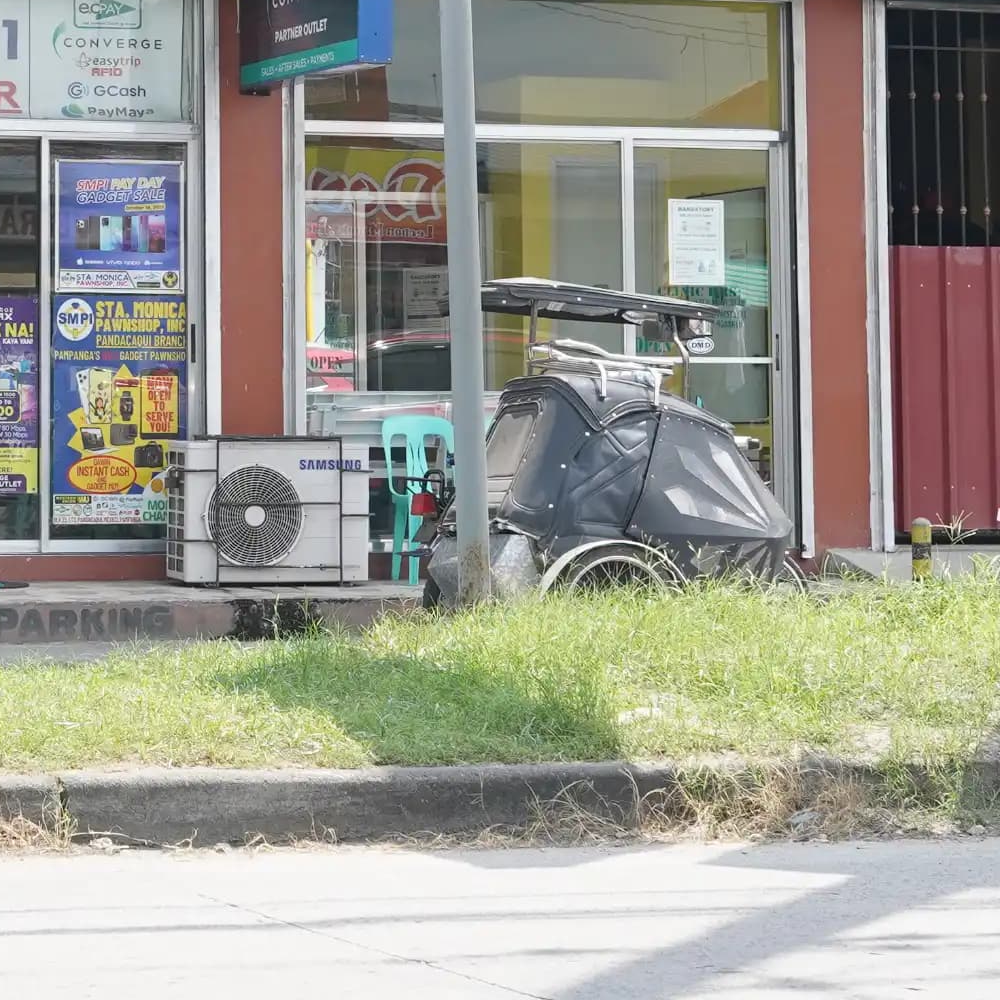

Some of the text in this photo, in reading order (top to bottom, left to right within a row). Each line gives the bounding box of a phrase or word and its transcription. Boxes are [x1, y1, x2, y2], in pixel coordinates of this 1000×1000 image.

[274, 17, 328, 44] PARTNER OUTLET
[2, 19, 18, 60] 1
[63, 37, 162, 50] CONVERGE
[92, 55, 141, 68] easytrip
[91, 67, 122, 77] RFID
[94, 85, 146, 97] GCash
[76, 176, 166, 192] SMPI PAY DAY
[76, 188, 166, 204] GADGET SALE
[96, 300, 186, 319] STA. MONICA
[58, 312, 92, 325] SMPI
[5, 322, 34, 338] NA!
[96, 318, 164, 334] PAWNSHOP,
[96, 335, 152, 347] PANDACAQUI
[54, 350, 101, 361] PAMPANGA'S
[120, 351, 147, 361] GADGET
[310, 356, 343, 369] OPEN
[148, 390, 172, 401] OPEN
[154, 401, 165, 411] TO
[146, 412, 174, 422] SERVE
[150, 422, 171, 433] YOU!
[299, 459, 361, 470] SAMSUNG
[77, 466, 129, 477] INSTANT CASH
